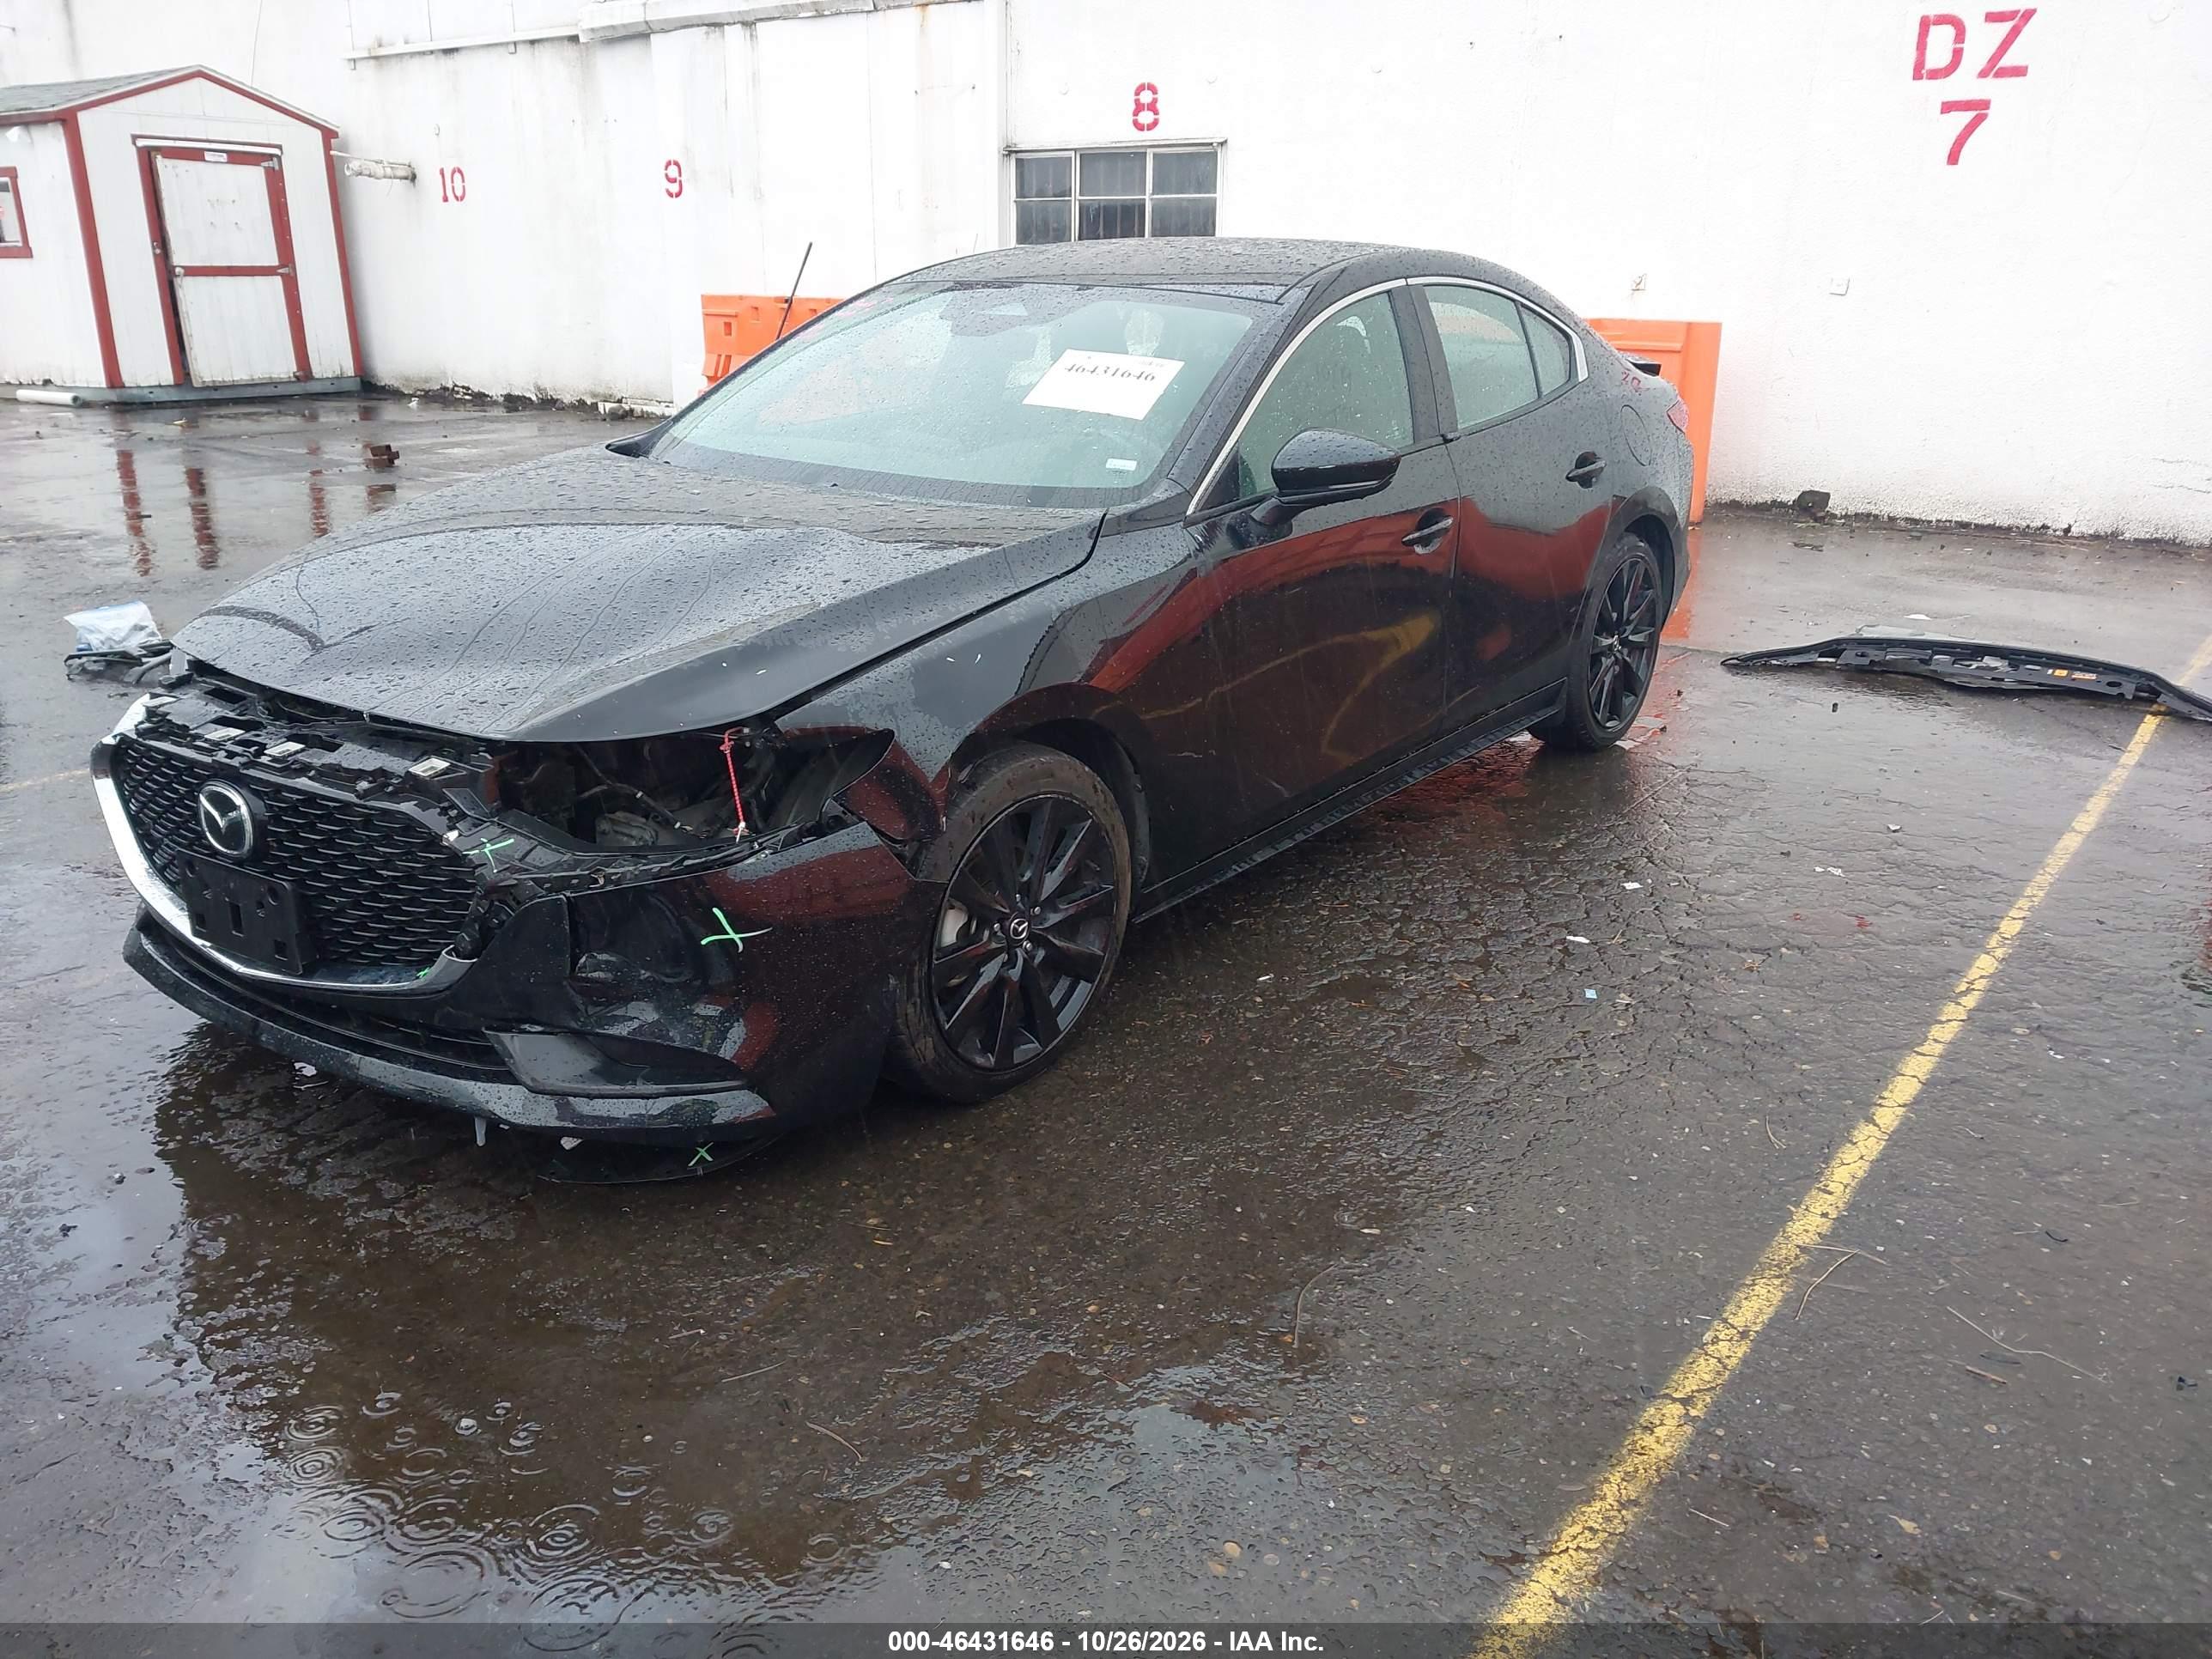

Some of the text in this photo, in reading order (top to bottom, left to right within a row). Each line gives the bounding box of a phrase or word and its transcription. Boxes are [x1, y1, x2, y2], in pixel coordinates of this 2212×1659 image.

[1912, 8, 2037, 81] DZ
[1132, 82, 1160, 131] 8
[1940, 99, 1991, 166] 7
[439, 166, 466, 203] 10
[664, 159, 684, 199] 9
